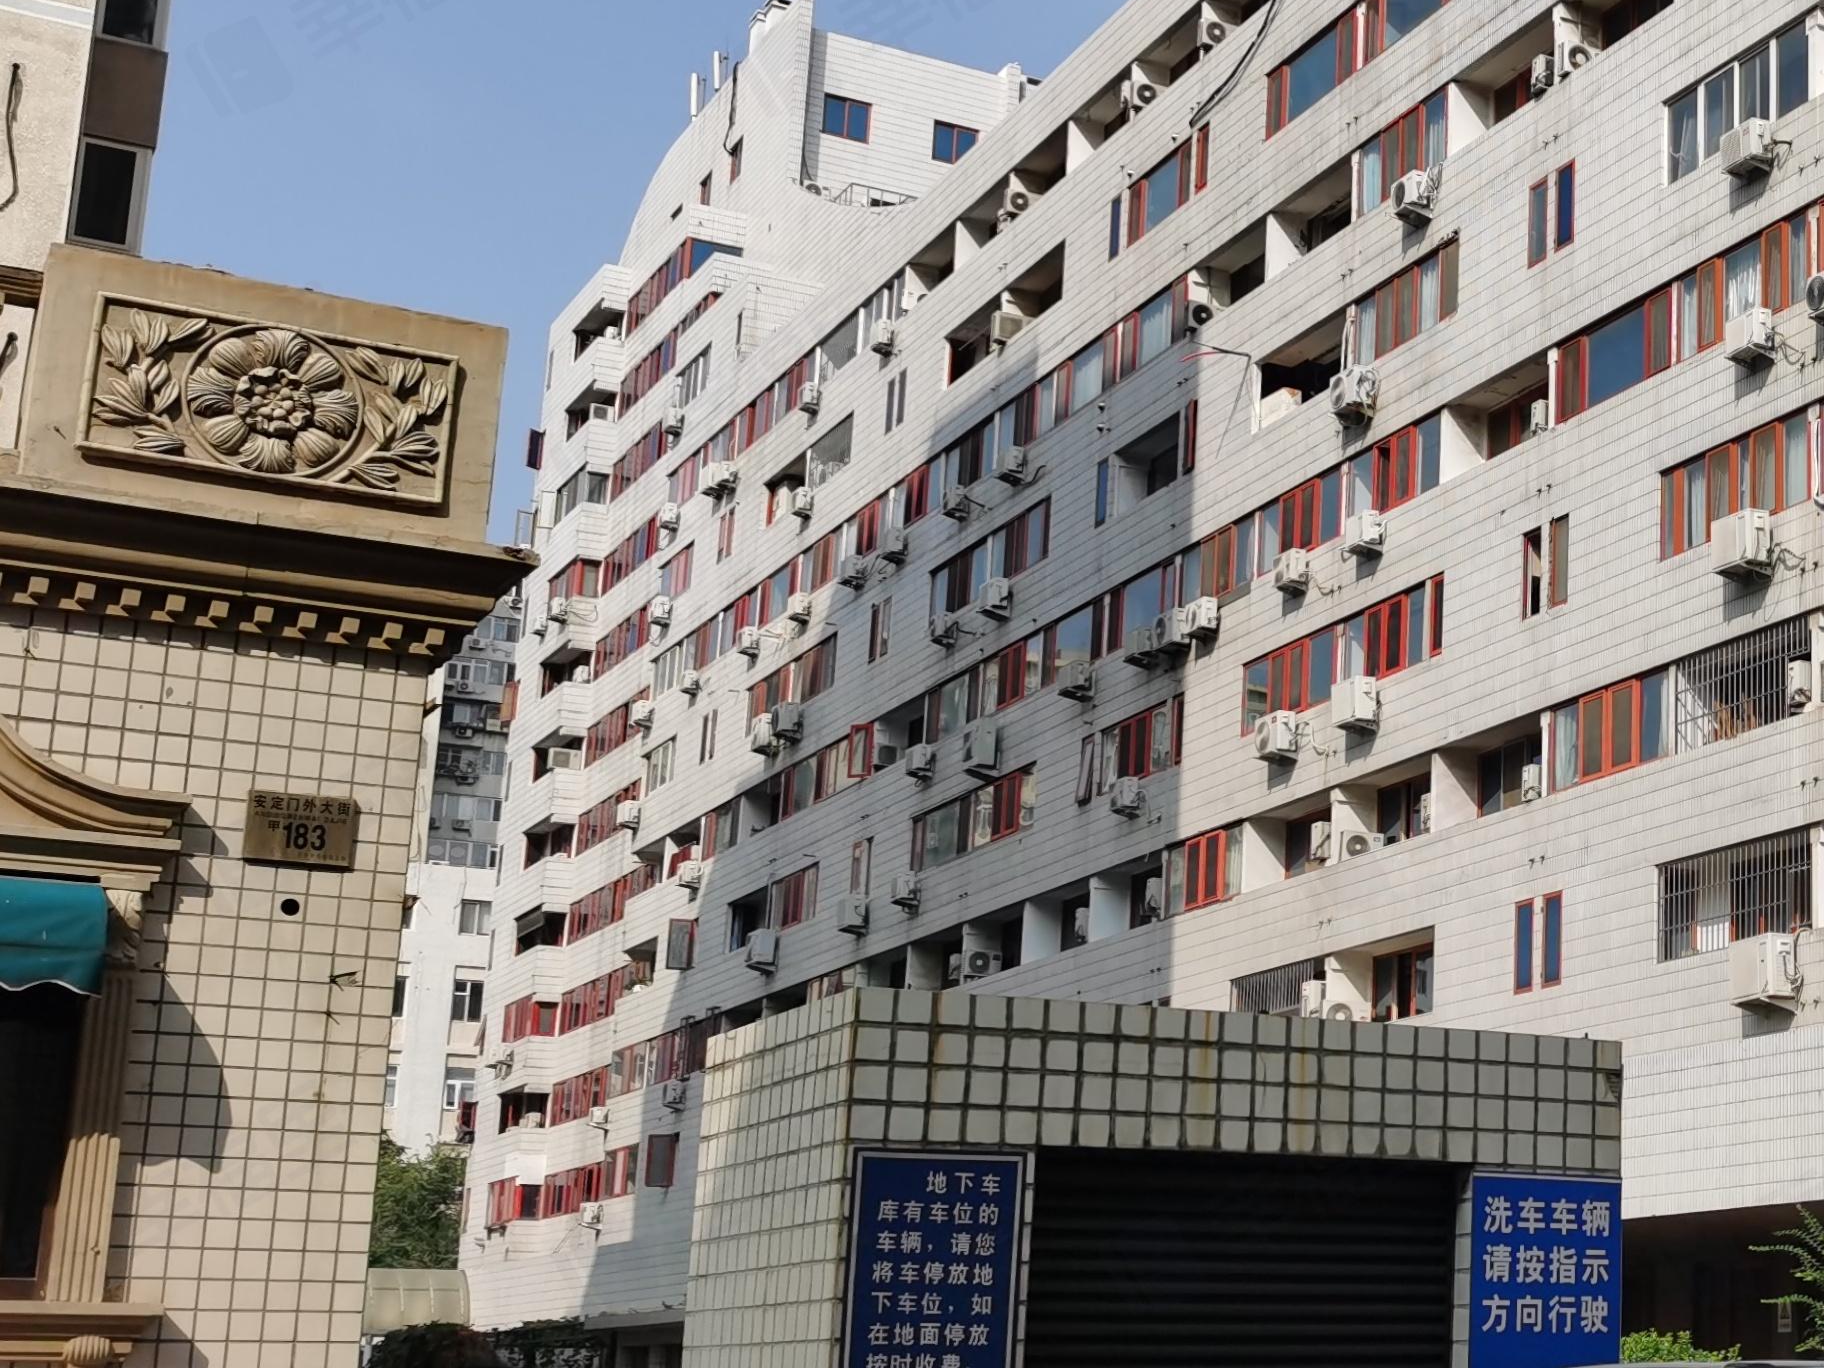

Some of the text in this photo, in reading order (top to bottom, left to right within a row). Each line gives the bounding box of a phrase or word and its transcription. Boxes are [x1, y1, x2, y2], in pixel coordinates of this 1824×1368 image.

[253, 794, 352, 817] 安定门外大街
[925, 1170, 1001, 1195] 地下车
[877, 1199, 1000, 1226] 库有车位的
[1483, 1195, 1611, 1238] 洗车车辆
[871, 1260, 994, 1286] 将车停放地
[1482, 1244, 1610, 1285] 请按指示
[1481, 1293, 1609, 1334] 方向行驶
[867, 1322, 990, 1347] 在地面停放
